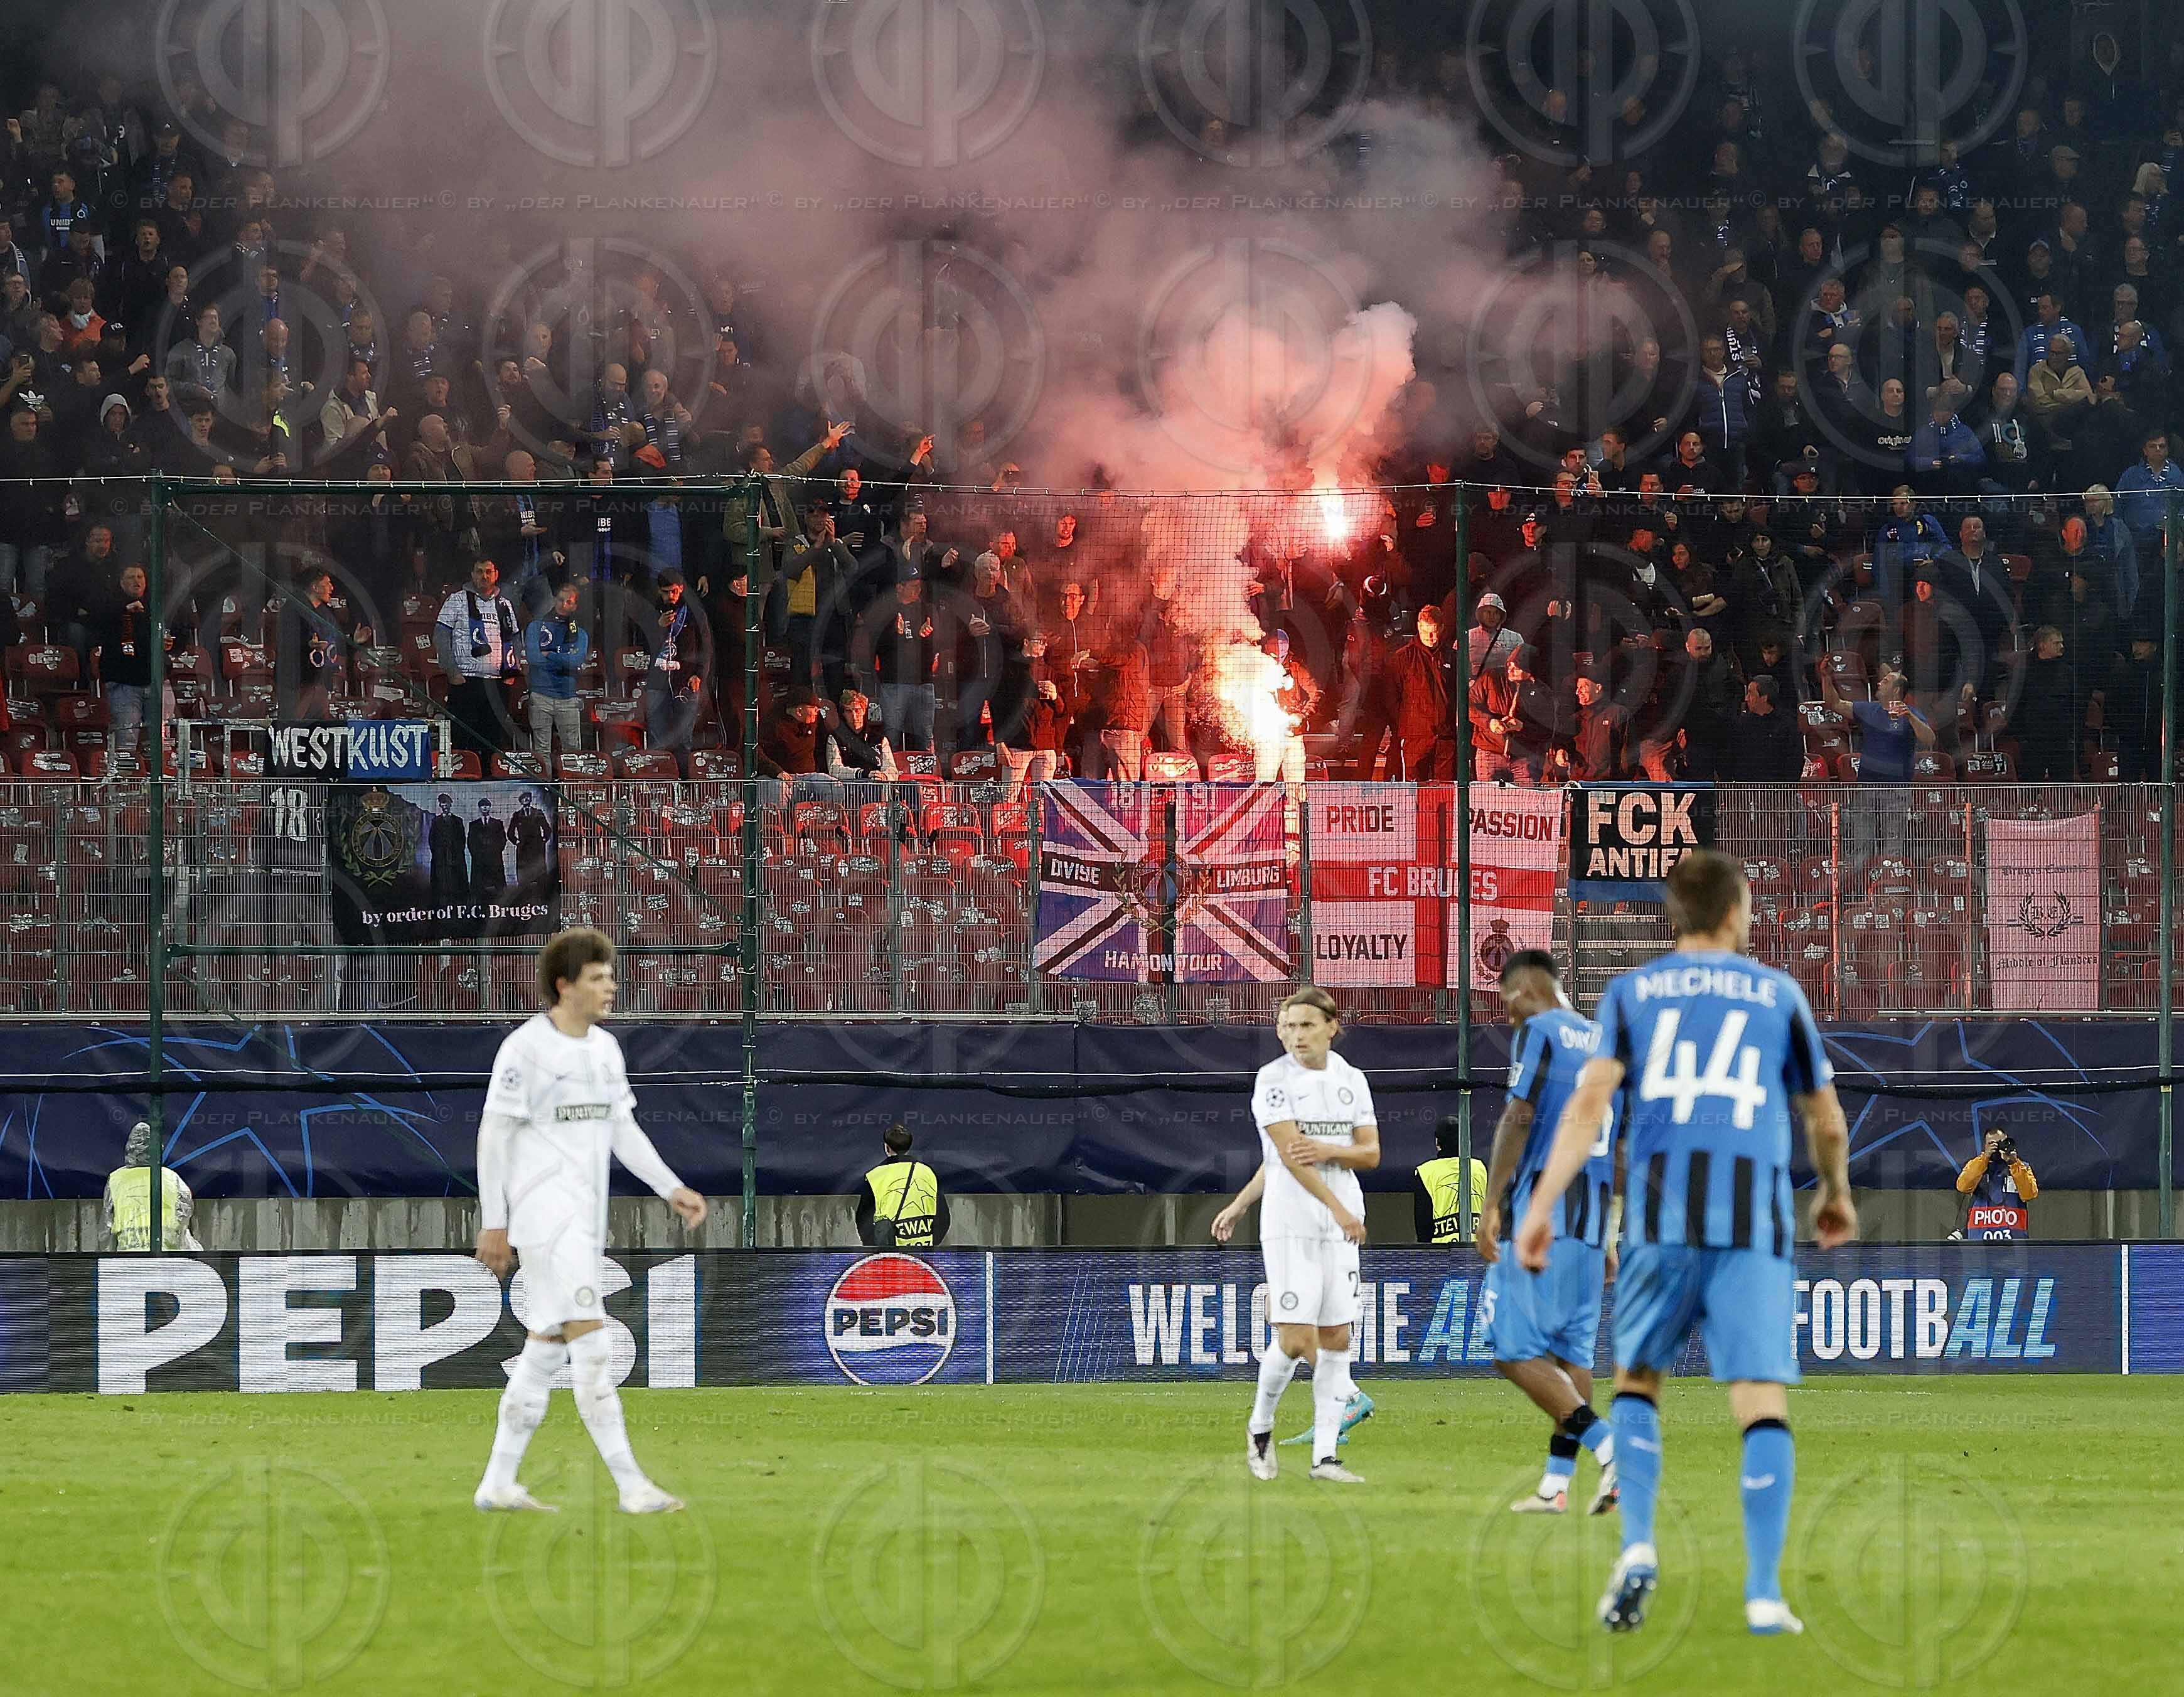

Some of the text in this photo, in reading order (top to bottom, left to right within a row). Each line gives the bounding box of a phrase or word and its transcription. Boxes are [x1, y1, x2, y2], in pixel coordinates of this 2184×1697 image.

[268, 724, 430, 771] WESTKUST
[1326, 805, 1394, 833] PRIDE
[1588, 791, 1699, 845] FCK
[1216, 866, 1280, 888] LIMBURG
[1368, 867, 1399, 896] FC
[361, 904, 549, 928] by order of F.C. Bruges
[1315, 934, 1407, 960] LOYALTY
[1635, 968, 1778, 1009] MECHELE
[1640, 1008, 1767, 1130] 44
[97, 1255, 696, 1395] PEPSI
[833, 1307, 948, 1337] PEPSI
[1128, 1282, 1411, 1365] WELCME
[1790, 1277, 2056, 1361] FOOTBALL
